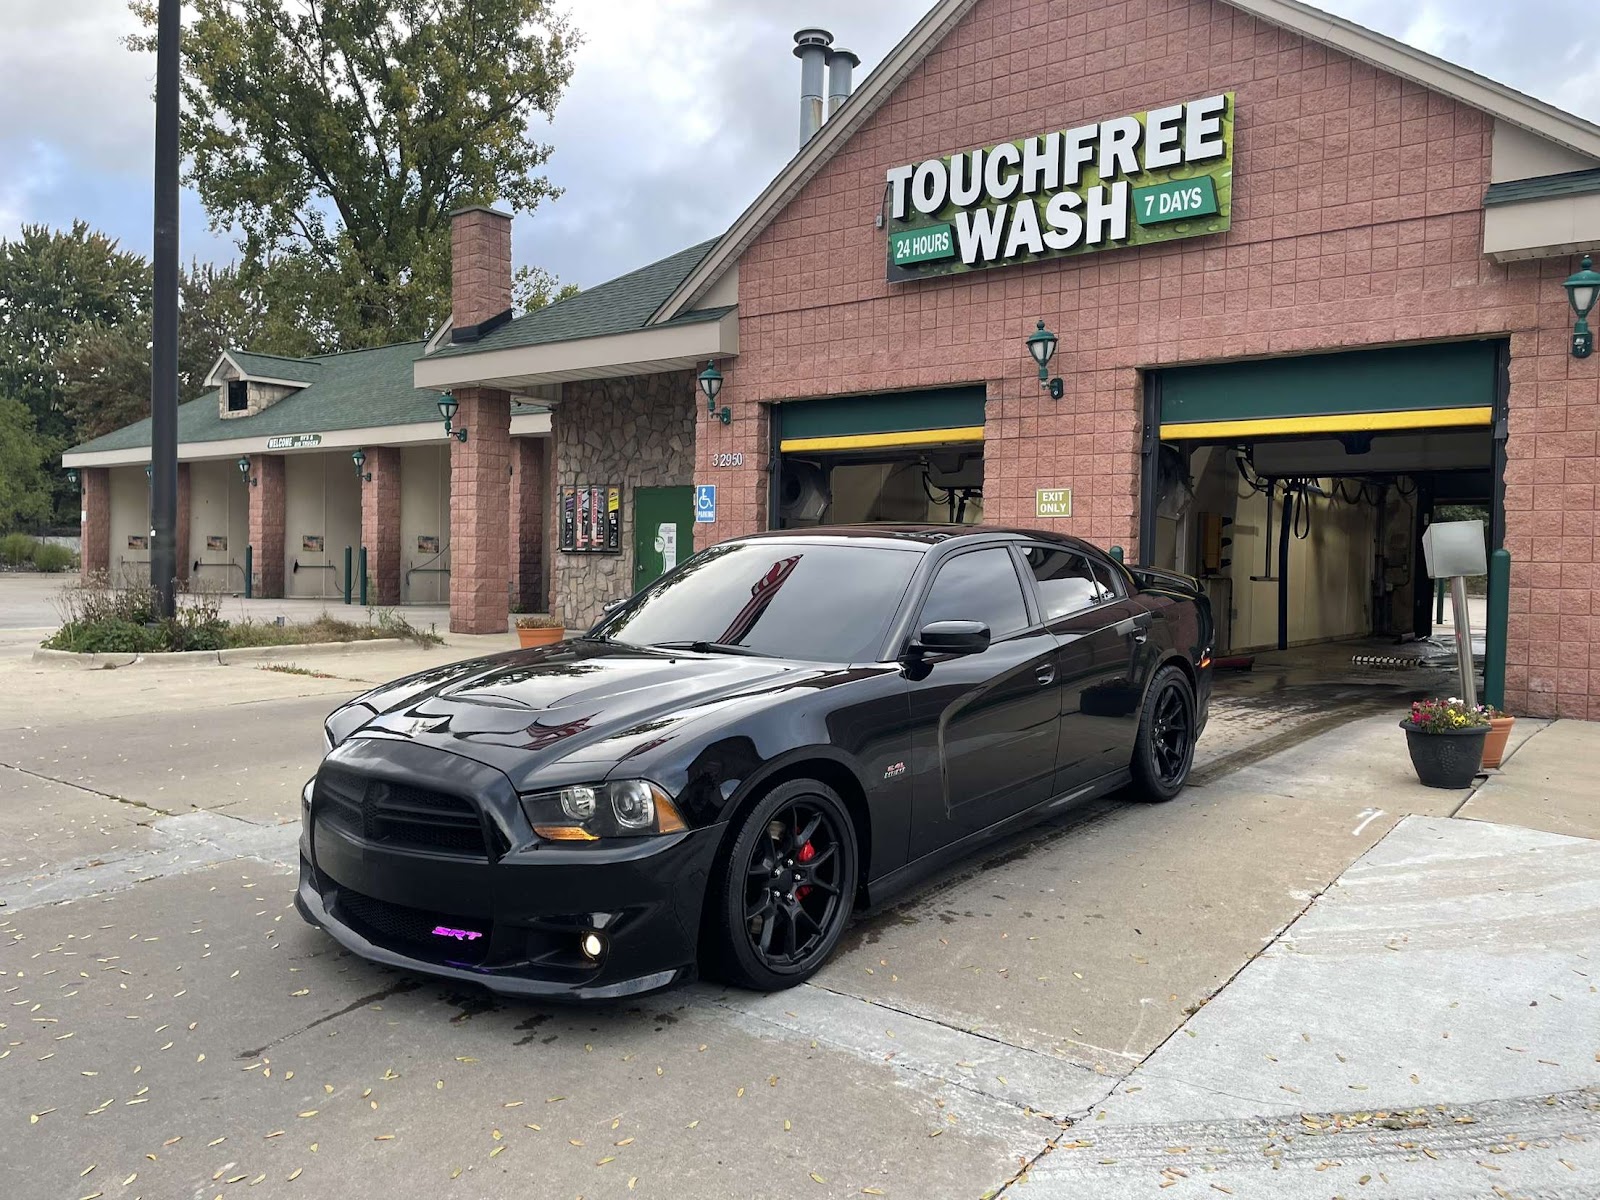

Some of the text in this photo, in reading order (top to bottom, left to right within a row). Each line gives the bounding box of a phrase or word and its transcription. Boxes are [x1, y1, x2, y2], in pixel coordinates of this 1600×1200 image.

[886, 94, 1226, 219] TOUCHFREE
[1144, 187, 1203, 216] 7 DAYS
[955, 180, 1129, 264] WASH
[897, 232, 949, 259] 24 HOURS
[269, 437, 293, 448] WELCOME
[712, 452, 743, 467] 32950
[1042, 491, 1064, 502] EXIT
[1040, 503, 1066, 513] ONLY
[431, 926, 483, 940] SRT
